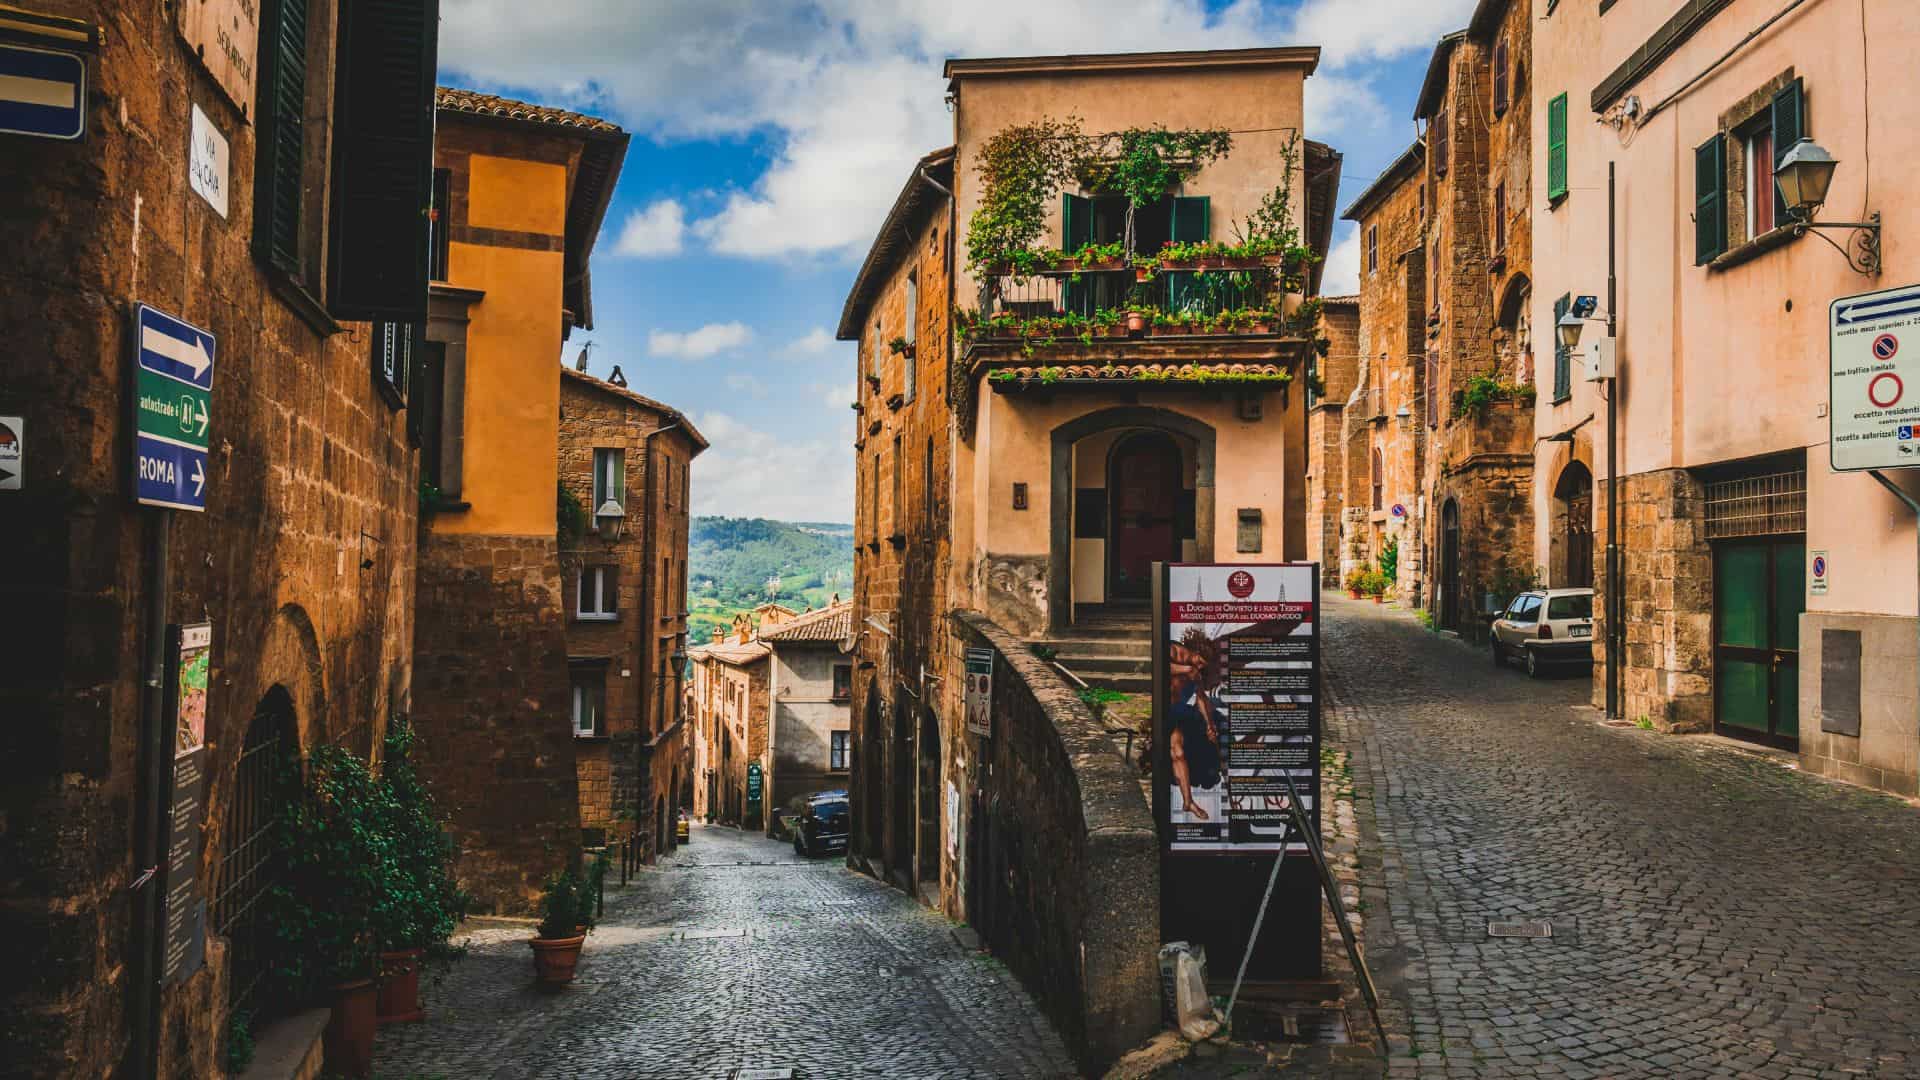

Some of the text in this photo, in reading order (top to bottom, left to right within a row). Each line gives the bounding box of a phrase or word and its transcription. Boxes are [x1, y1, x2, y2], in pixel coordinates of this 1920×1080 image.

[205, 131, 216, 161] VIA
[1854, 406, 1920, 419] eccetto residenti
[140, 455, 175, 484] ROMA
[1186, 603, 1214, 612] DUOMO
[1223, 603, 1252, 612] ORVIETO
